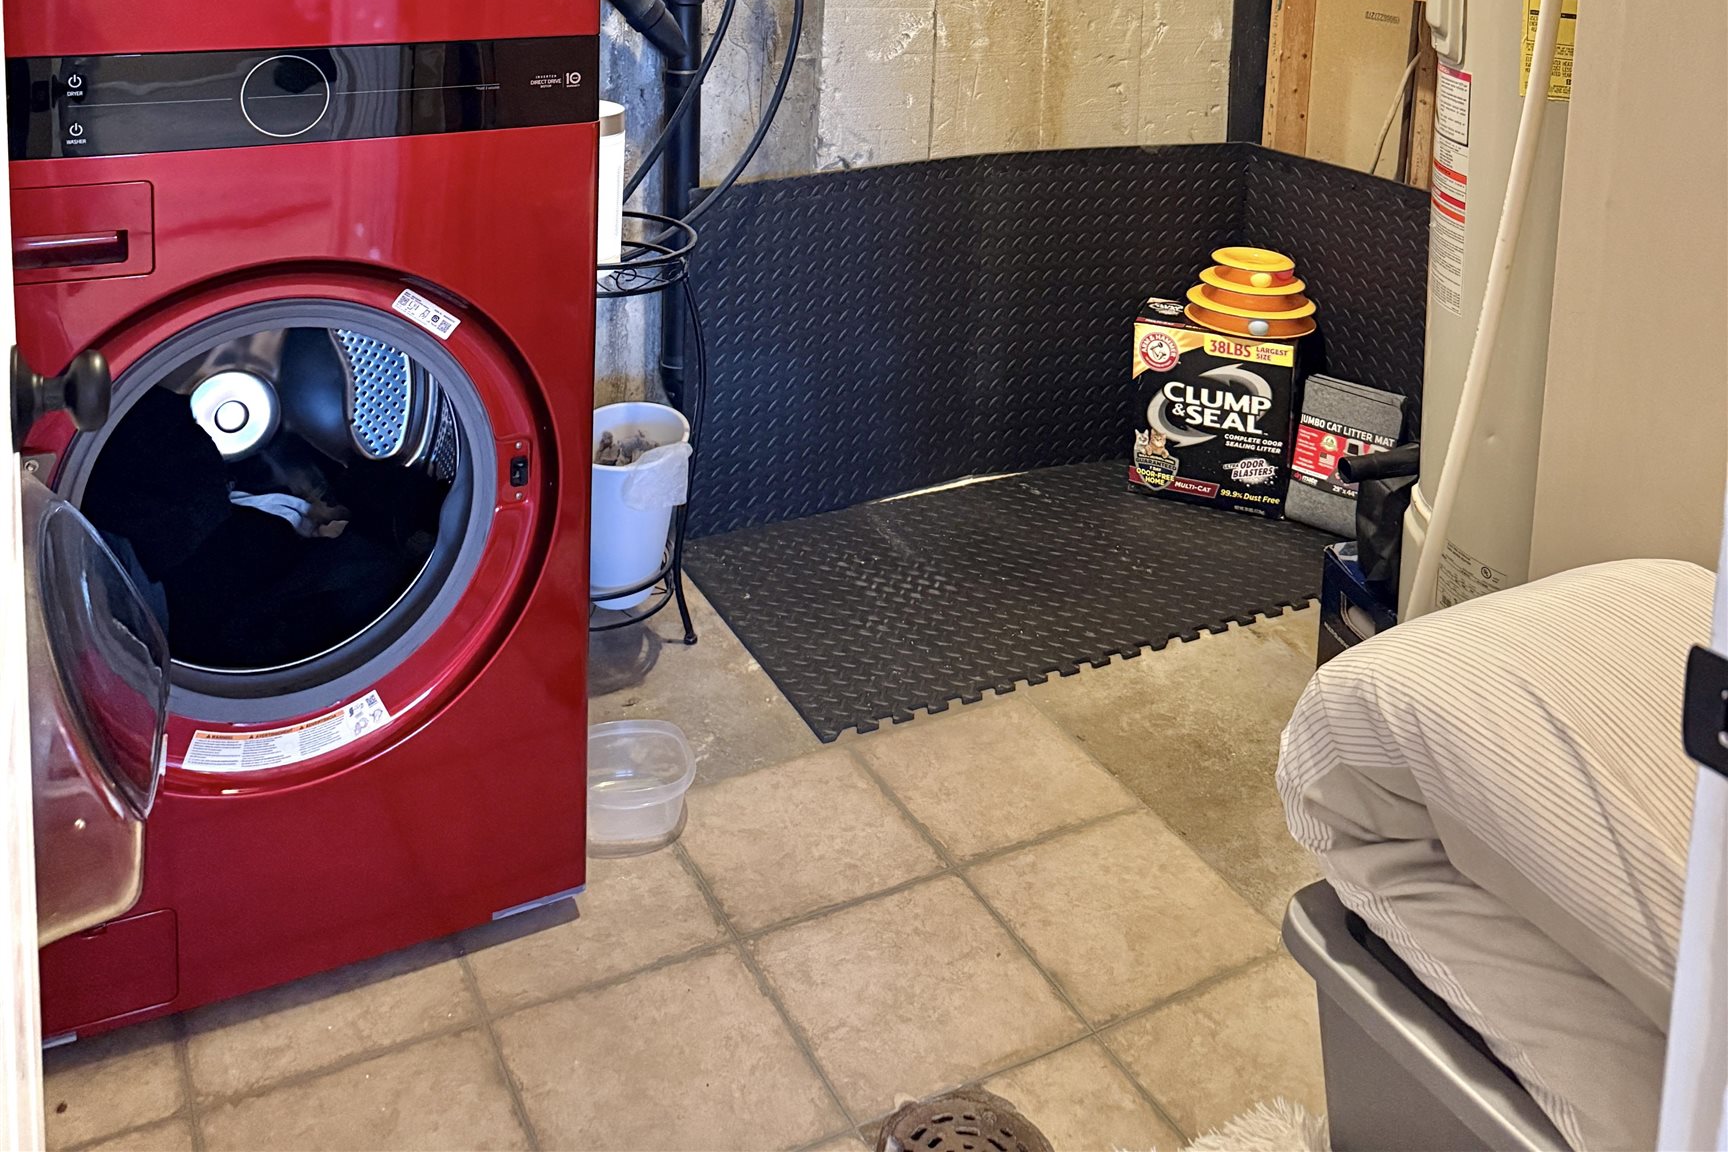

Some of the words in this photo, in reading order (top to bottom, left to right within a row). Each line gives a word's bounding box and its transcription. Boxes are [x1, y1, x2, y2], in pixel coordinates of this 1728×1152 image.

[1209, 339, 1251, 358] 38LBS
[1256, 346, 1289, 356] LARGEST
[1256, 353, 1272, 361] SIZE
[1163, 381, 1272, 415] CLUMP
[1171, 402, 1263, 435] &SEAL
[1300, 413, 1325, 428] JUMBO
[1326, 420, 1342, 433] CAT
[1343, 426, 1373, 443] LITTER
[1374, 435, 1396, 448] MAT
[1224, 433, 1261, 444] COMPLETE
[1262, 438, 1283, 448] ODOR
[1225, 440, 1256, 451] SEALING
[1256, 445, 1282, 455] LITTER
[1240, 459, 1265, 469] ODOR
[1136, 467, 1175, 482] ODOR-FREE
[1232, 467, 1274, 478] BLASTERS
[1145, 476, 1165, 486] HOME
[1174, 481, 1212, 493] MULTI-CAT
[1220, 488, 1243, 500] 99.9%
[1243, 492, 1262, 502] Dust
[1262, 495, 1281, 505] Free
